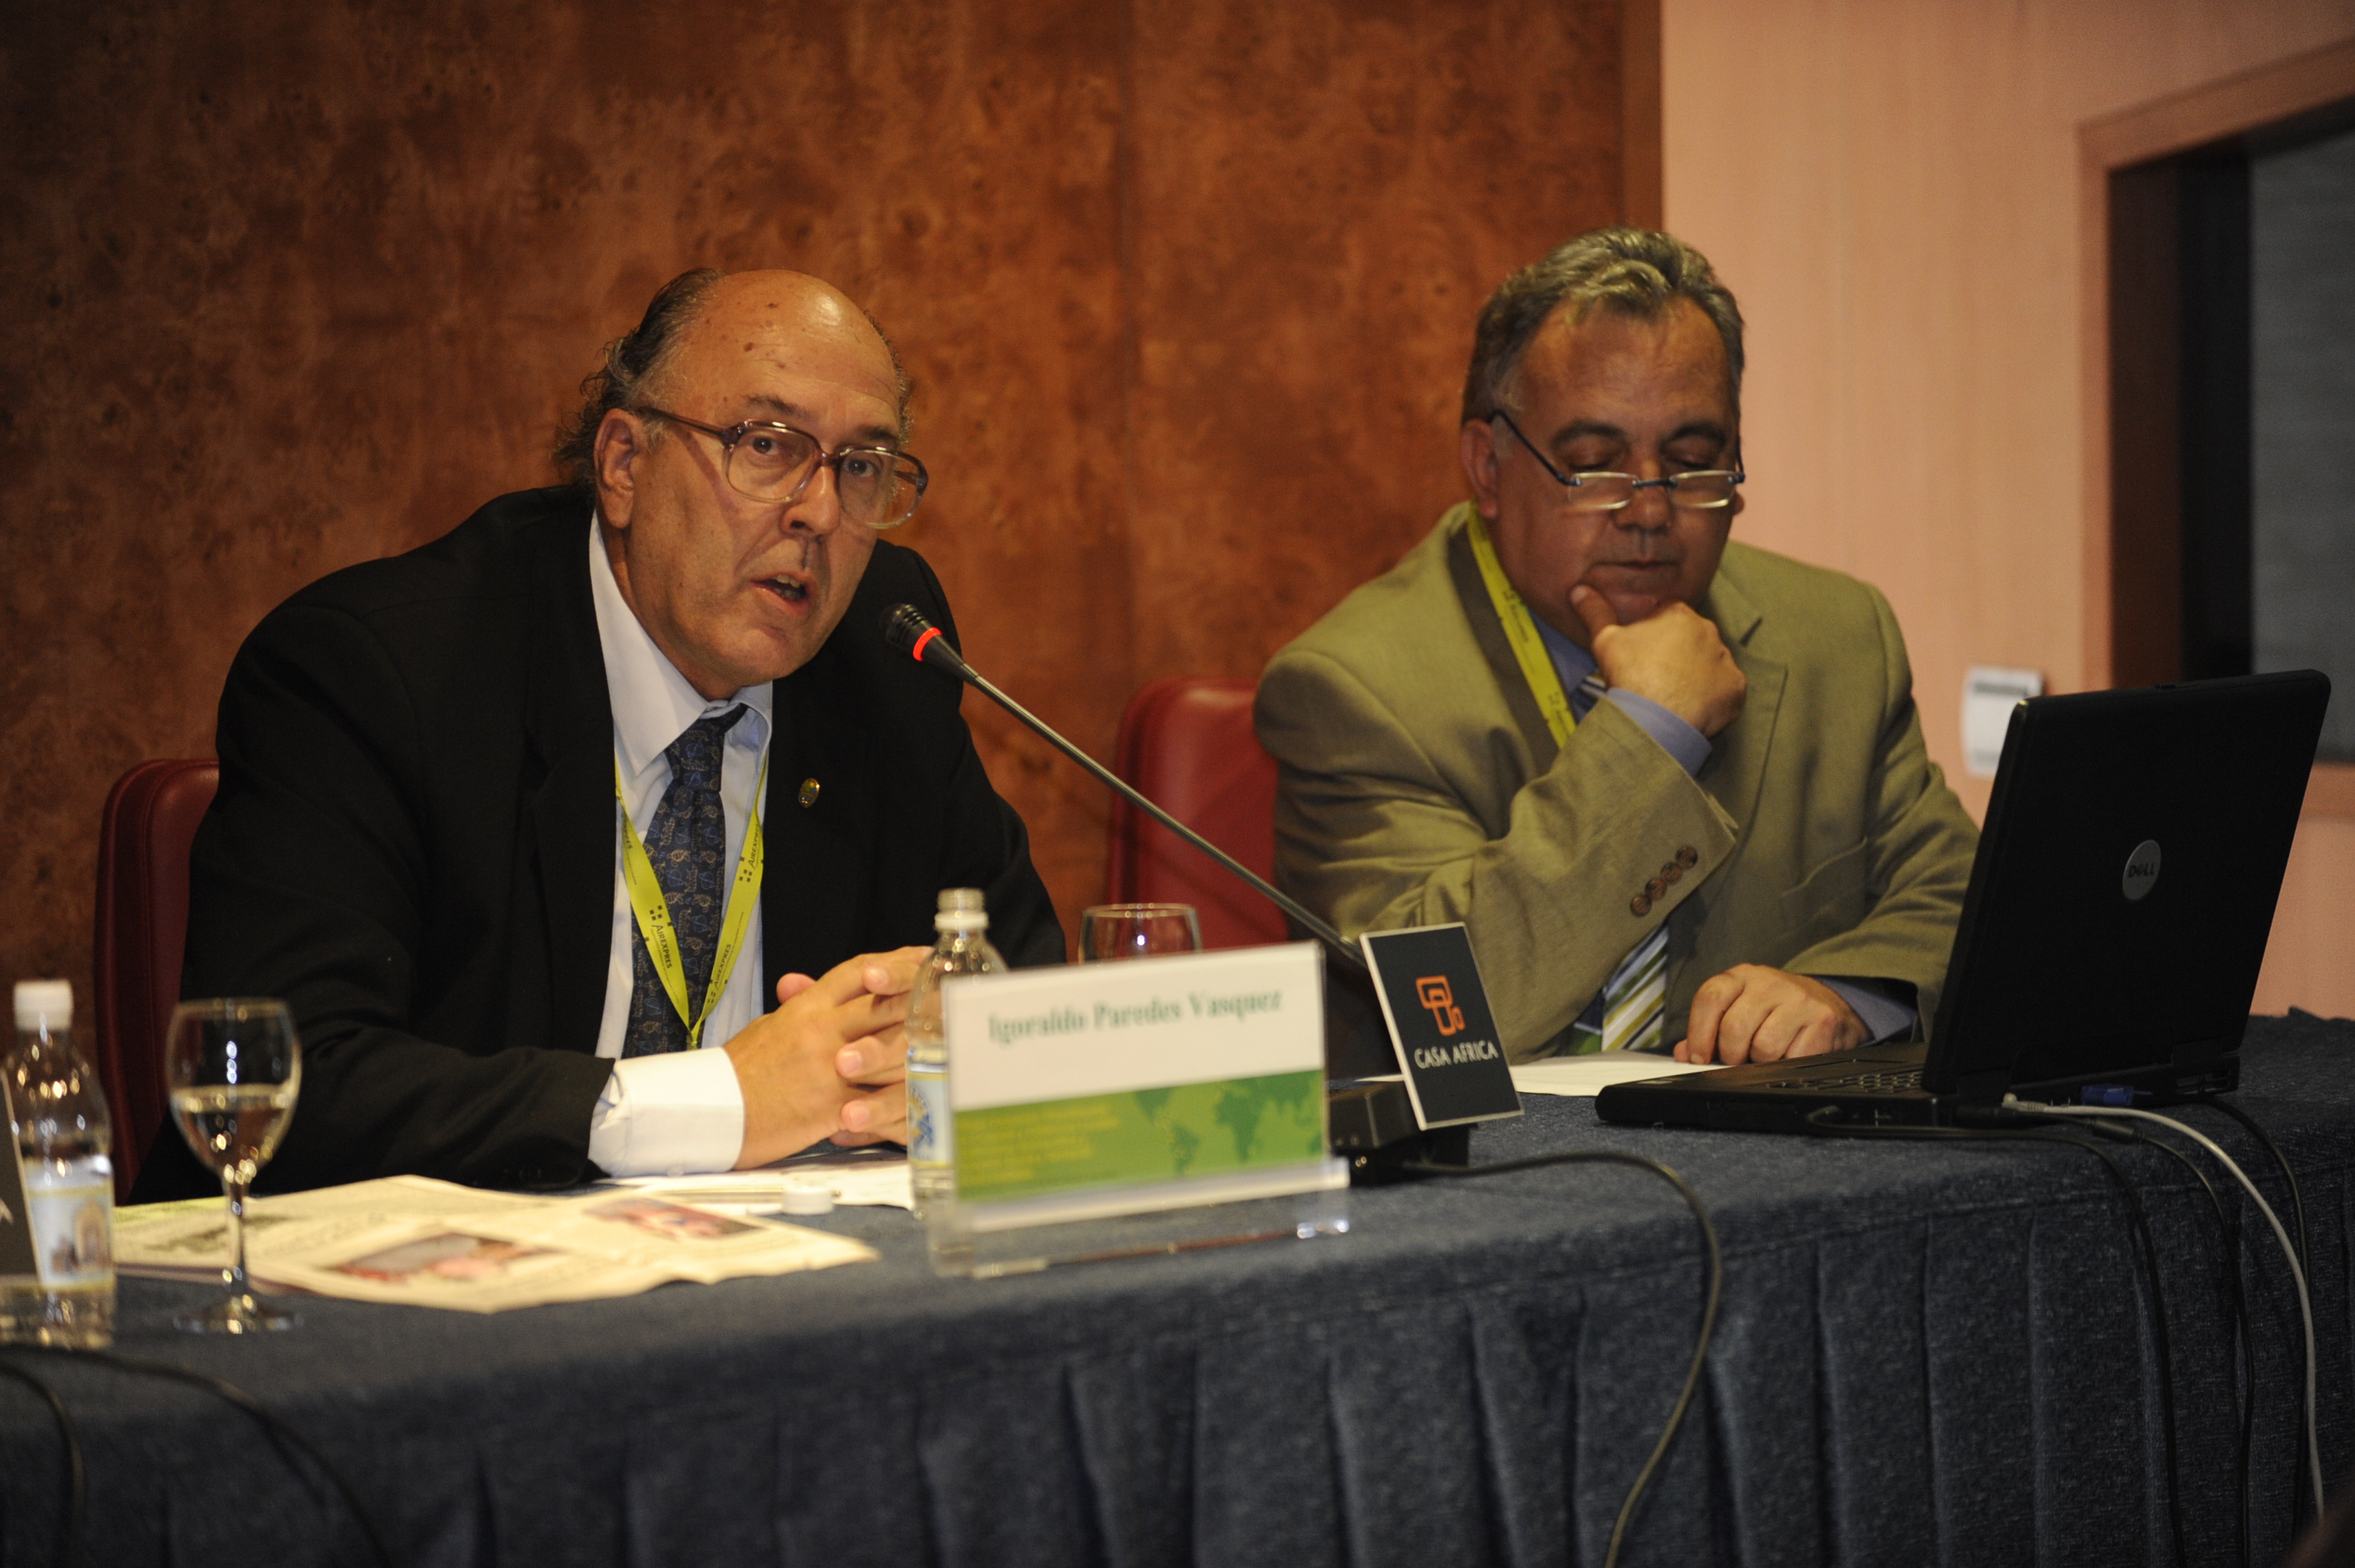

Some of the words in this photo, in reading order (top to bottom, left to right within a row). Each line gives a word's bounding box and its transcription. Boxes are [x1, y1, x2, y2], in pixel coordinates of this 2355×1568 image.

[2128, 862, 2155, 878] DELL
[651, 925, 672, 969] AIREXPRES
[714, 943, 731, 991] AIREXPRES
[1092, 996, 1182, 1029] Paredes
[1188, 990, 1283, 1022] Vasquez
[1414, 1046, 1451, 1069] CASA
[1453, 1040, 1499, 1064] AFRICA
